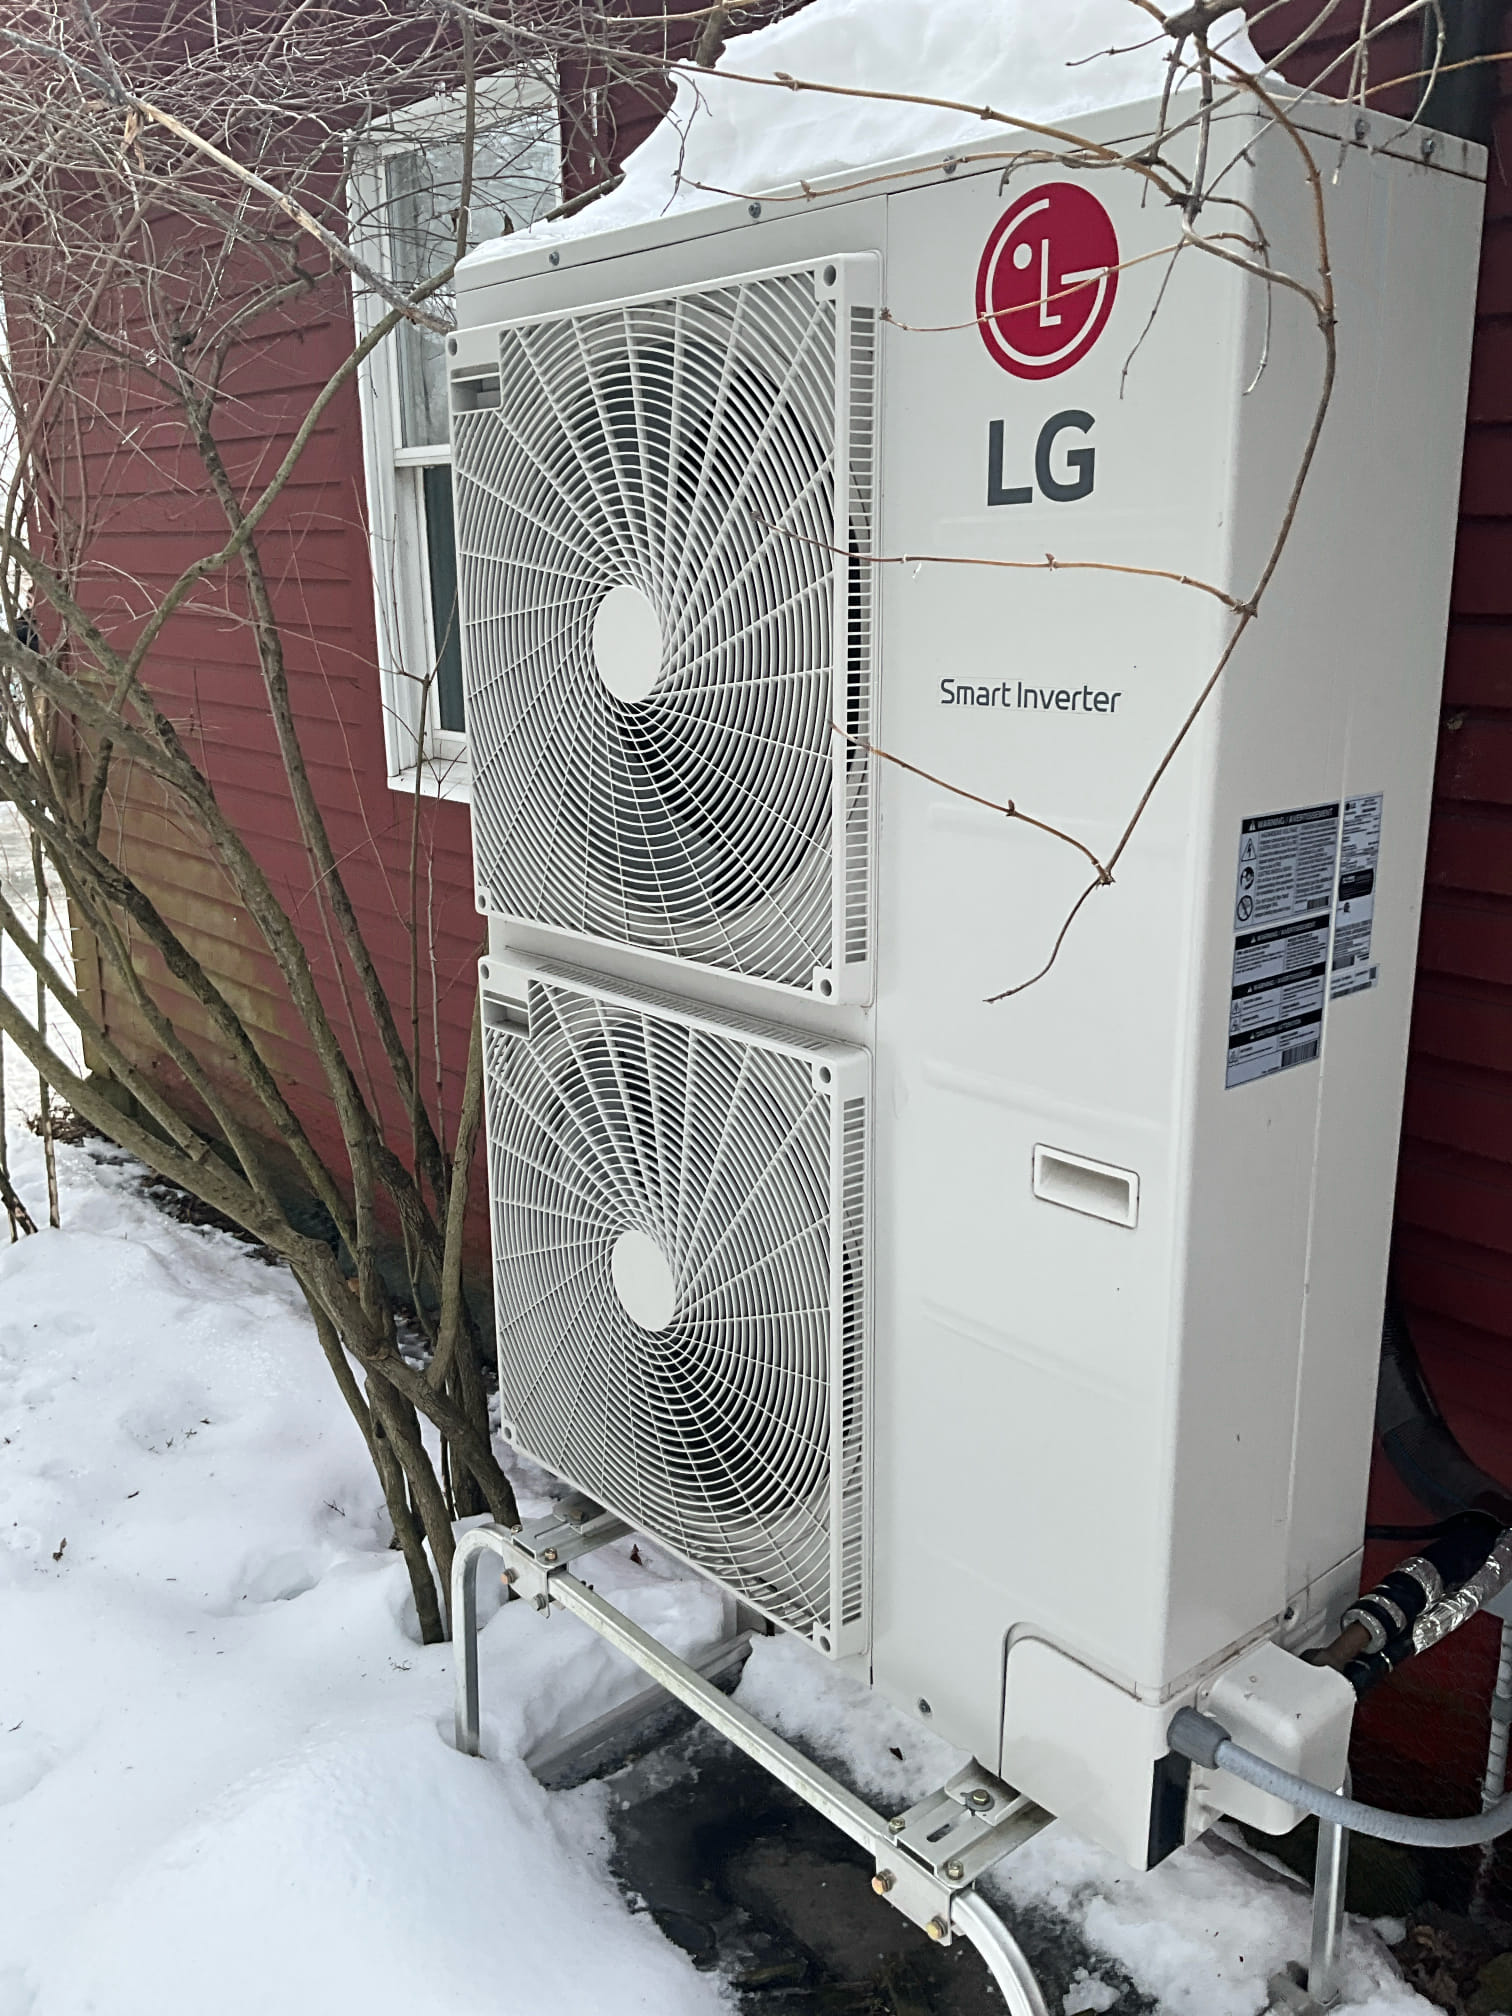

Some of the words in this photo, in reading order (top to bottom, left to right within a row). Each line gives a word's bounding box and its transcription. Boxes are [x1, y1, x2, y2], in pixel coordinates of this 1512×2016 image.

[987, 409, 1096, 507] LG
[940, 678, 1011, 708] Smart
[1017, 680, 1122, 713] Inverter
[1257, 816, 1285, 829] WARNING
